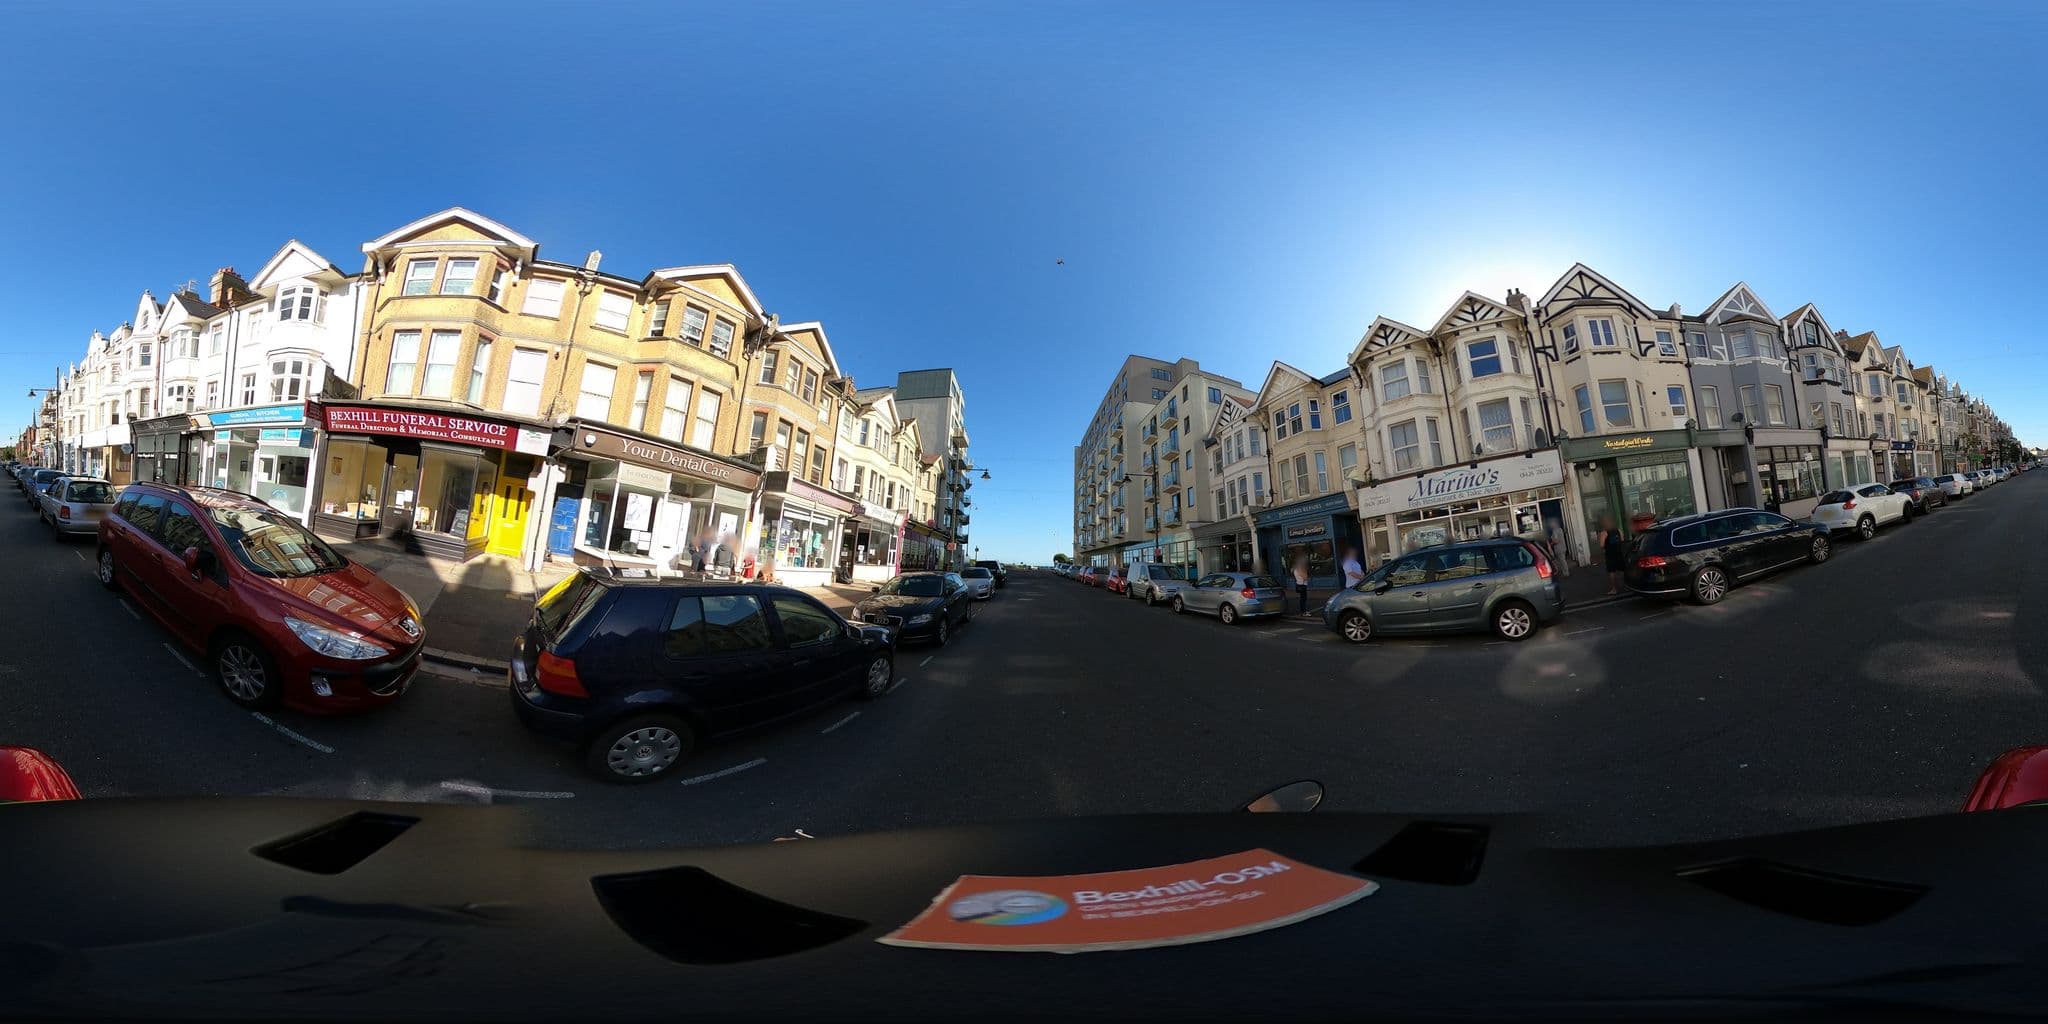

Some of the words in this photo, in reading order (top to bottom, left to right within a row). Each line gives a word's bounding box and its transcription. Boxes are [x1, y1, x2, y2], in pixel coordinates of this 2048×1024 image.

[330, 411, 381, 422] BEXHILL
[383, 412, 446, 428] FUNERAL
[448, 418, 508, 436] SERVICE
[399, 424, 406, 433] &
[621, 438, 657, 460] Your
[660, 449, 731, 480] DentalCare
[1408, 468, 1499, 502] Marino's
[1073, 861, 1291, 904] Bexhill-OSM
